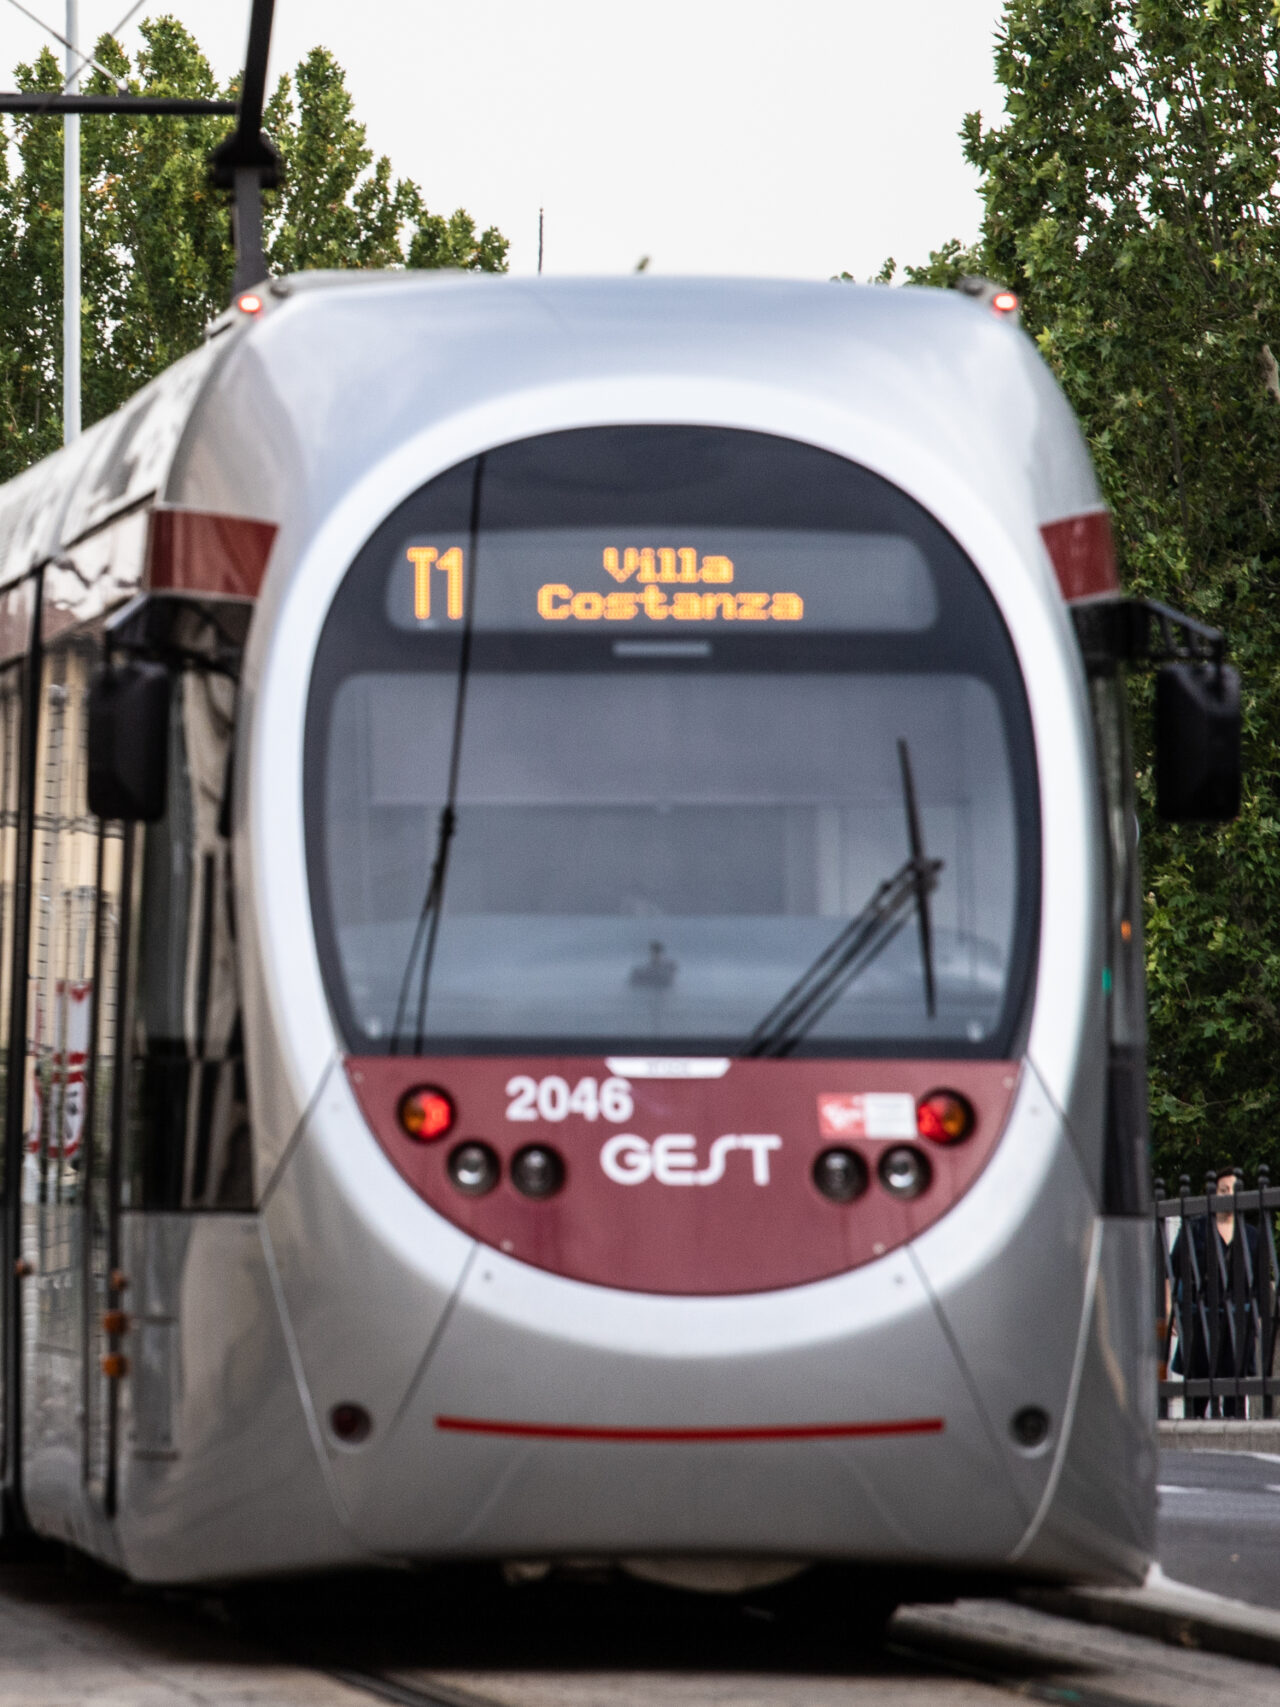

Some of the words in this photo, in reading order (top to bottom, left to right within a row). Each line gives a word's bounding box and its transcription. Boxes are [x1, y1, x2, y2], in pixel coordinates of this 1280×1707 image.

[407, 547, 463, 619] T1
[603, 548, 733, 583] Villa
[538, 584, 803, 620] Costanza
[506, 1076, 634, 1122] 2046
[600, 1134, 782, 1186] GEST
